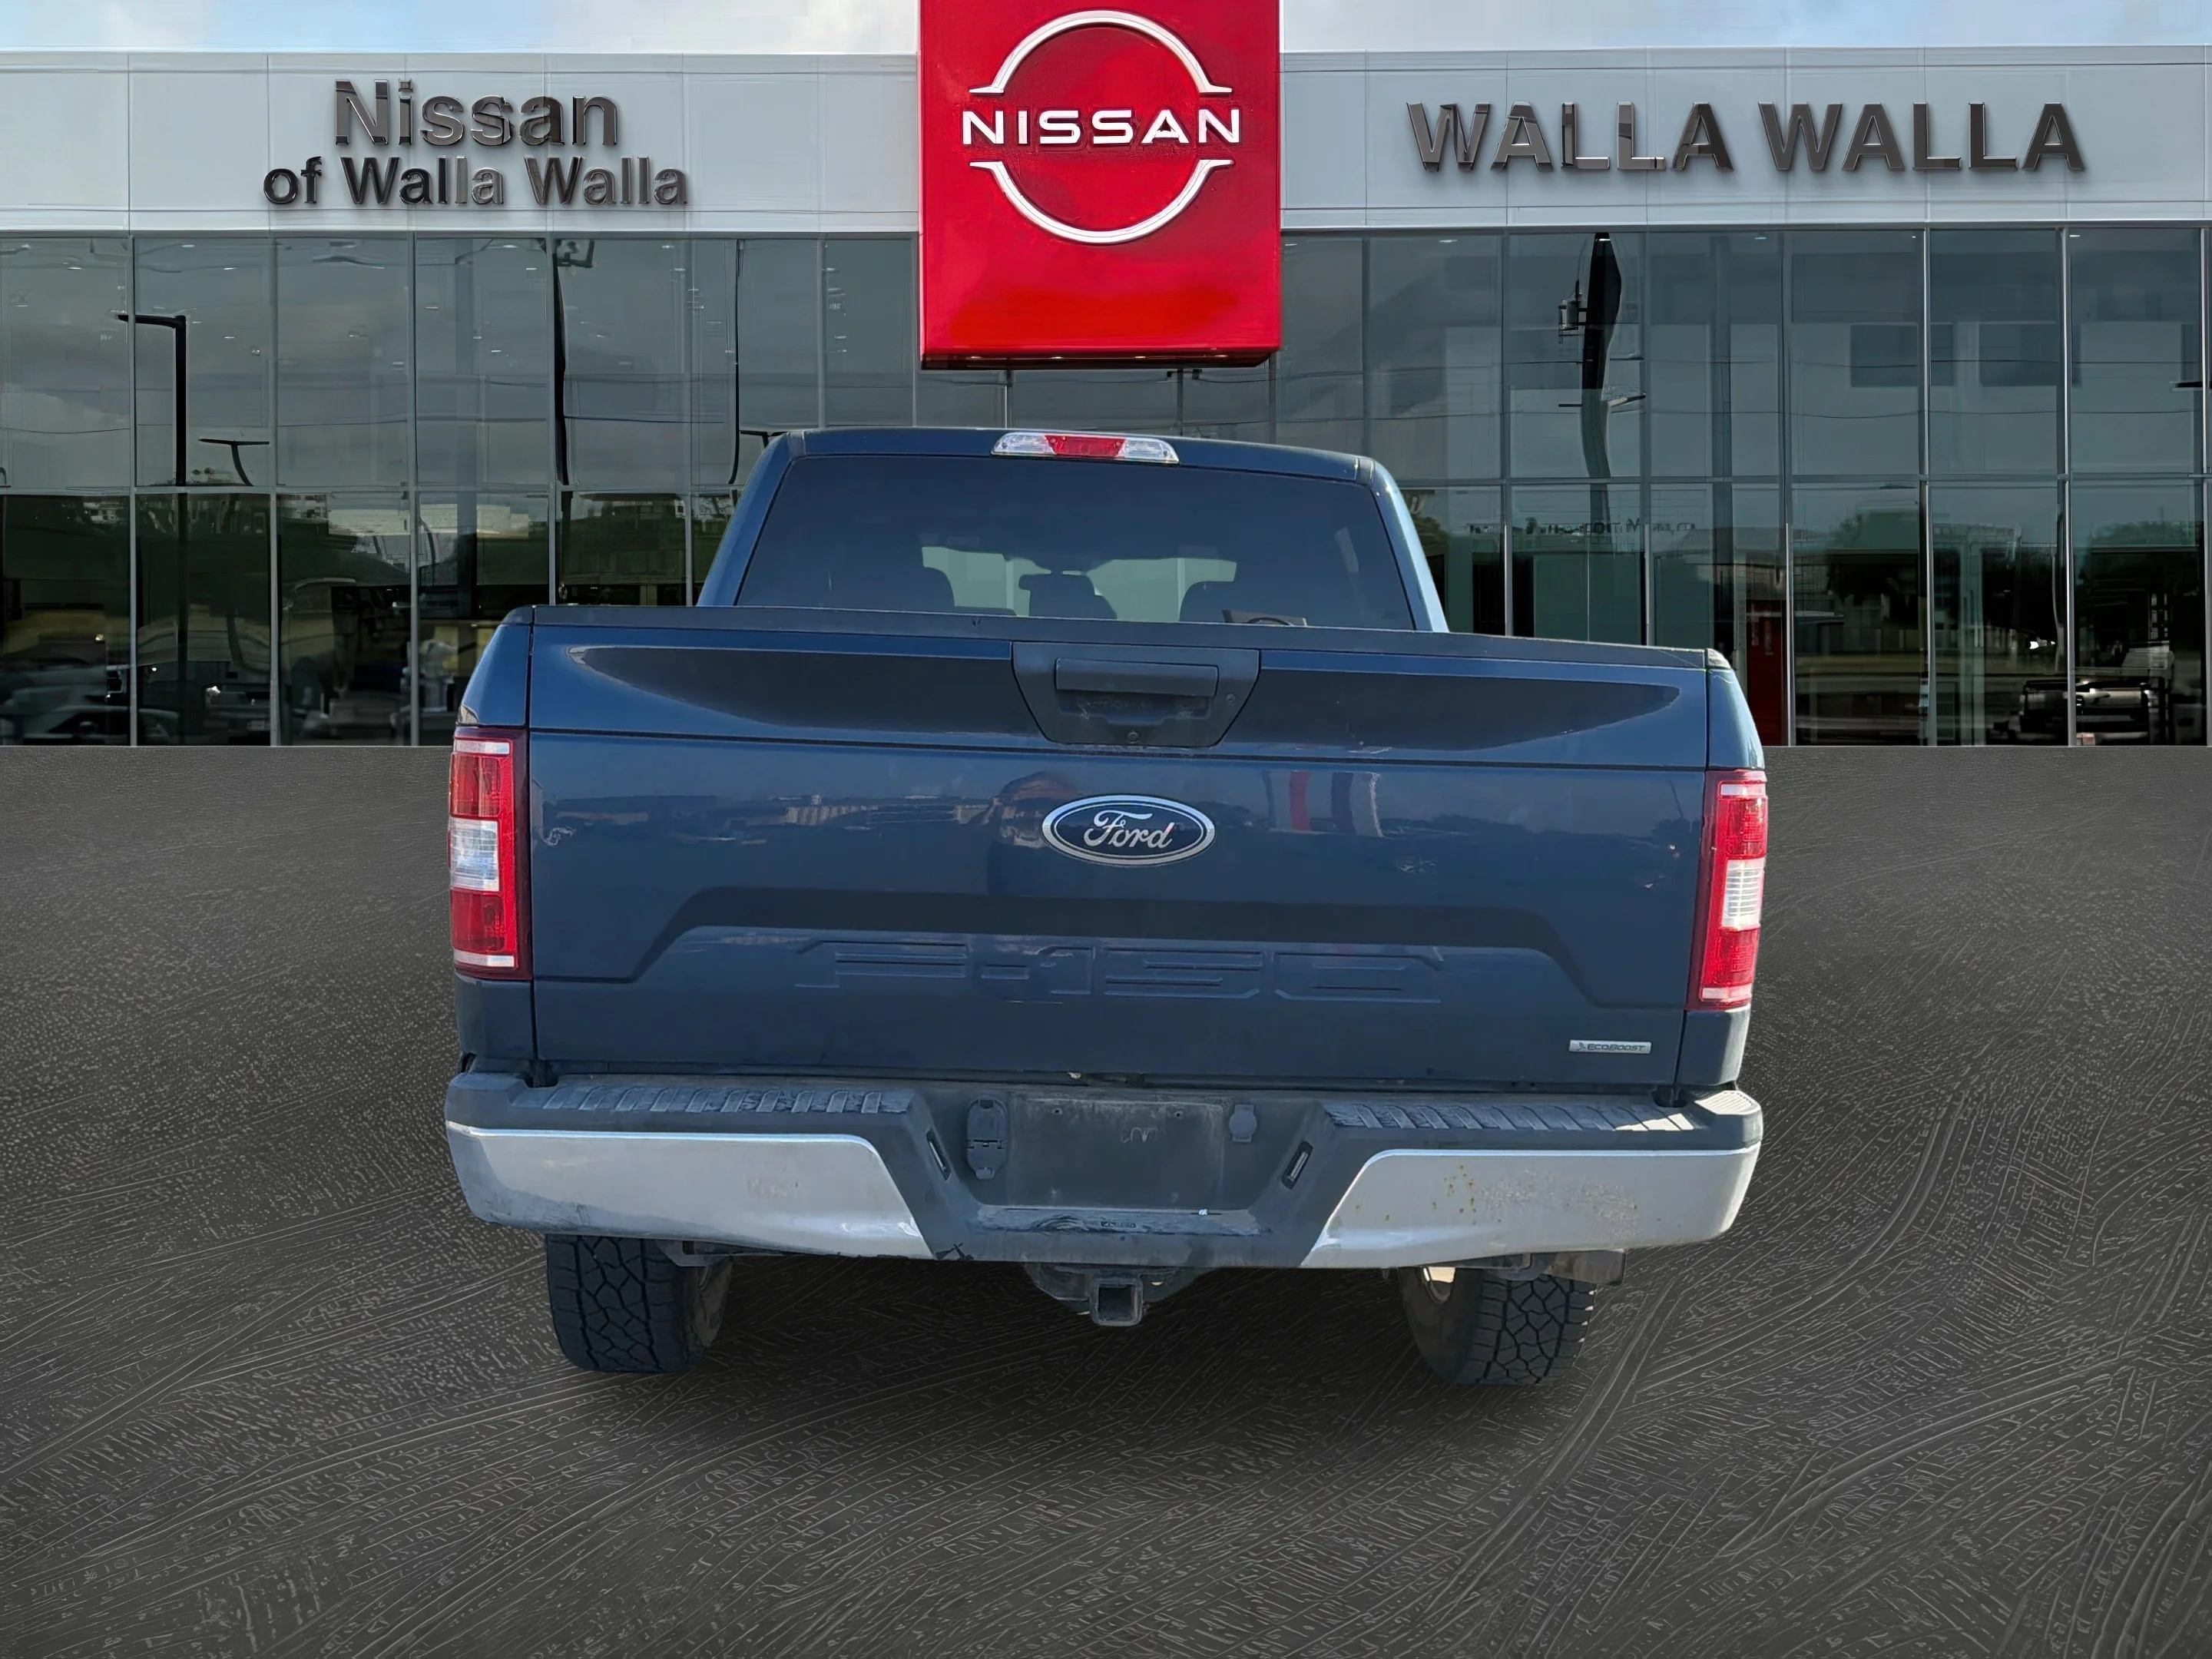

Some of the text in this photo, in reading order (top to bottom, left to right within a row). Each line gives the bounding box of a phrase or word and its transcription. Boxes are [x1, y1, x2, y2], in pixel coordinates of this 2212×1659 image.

[335, 78, 618, 146] Nissan
[962, 109, 1240, 144] NISSAN
[1406, 101, 2085, 171] WALLA WALLA
[263, 156, 687, 204] of Walla Walla
[1083, 809, 1175, 849] Ford
